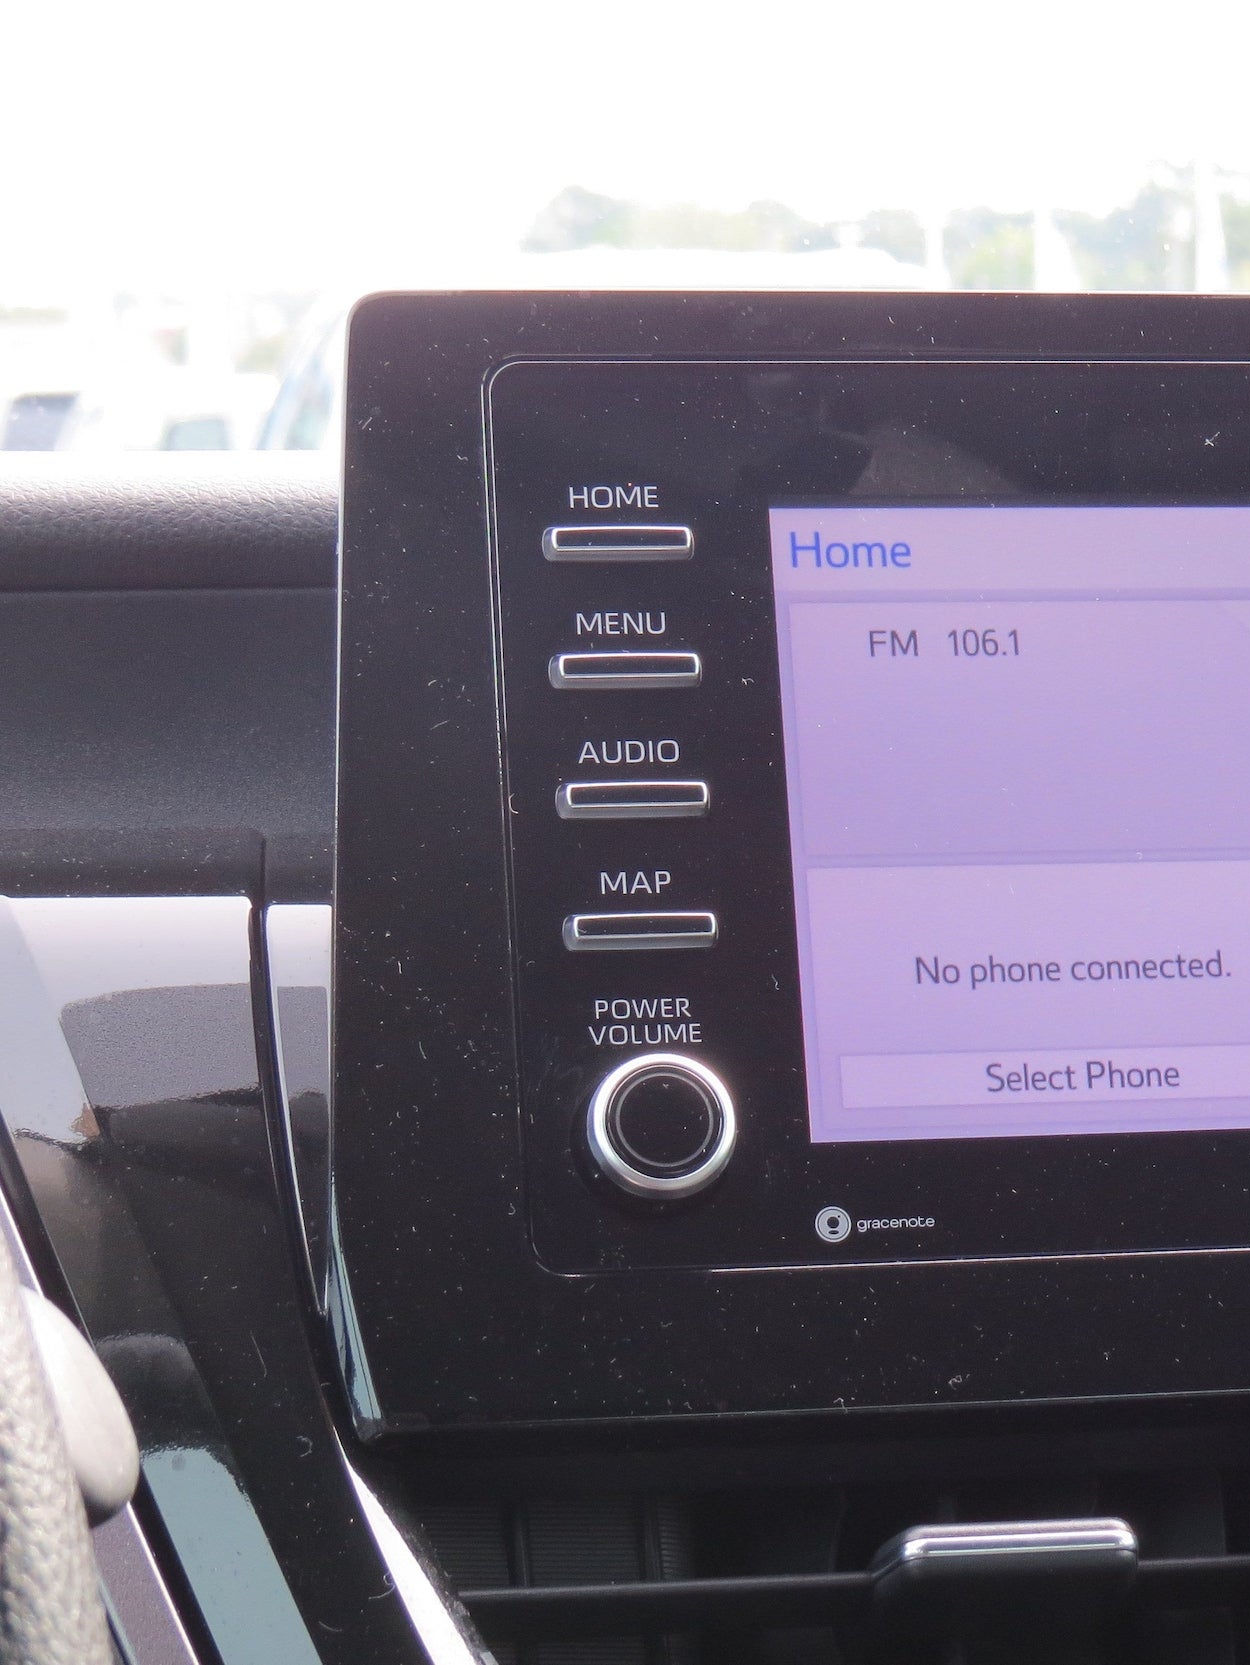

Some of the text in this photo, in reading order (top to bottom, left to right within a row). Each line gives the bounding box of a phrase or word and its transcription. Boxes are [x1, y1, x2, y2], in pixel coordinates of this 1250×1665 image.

[568, 486, 659, 508] HOME
[790, 531, 911, 568] Home
[576, 612, 666, 635] MENU
[868, 629, 1020, 657] FM 106.1
[578, 740, 680, 763] AUDIO
[600, 871, 671, 895] MAP
[915, 950, 1232, 989] No phone connected.
[594, 998, 691, 1019] POWER
[588, 1023, 703, 1045] VOLUME
[986, 1061, 1180, 1092] Select Phone
[856, 1216, 936, 1233] gracenote
